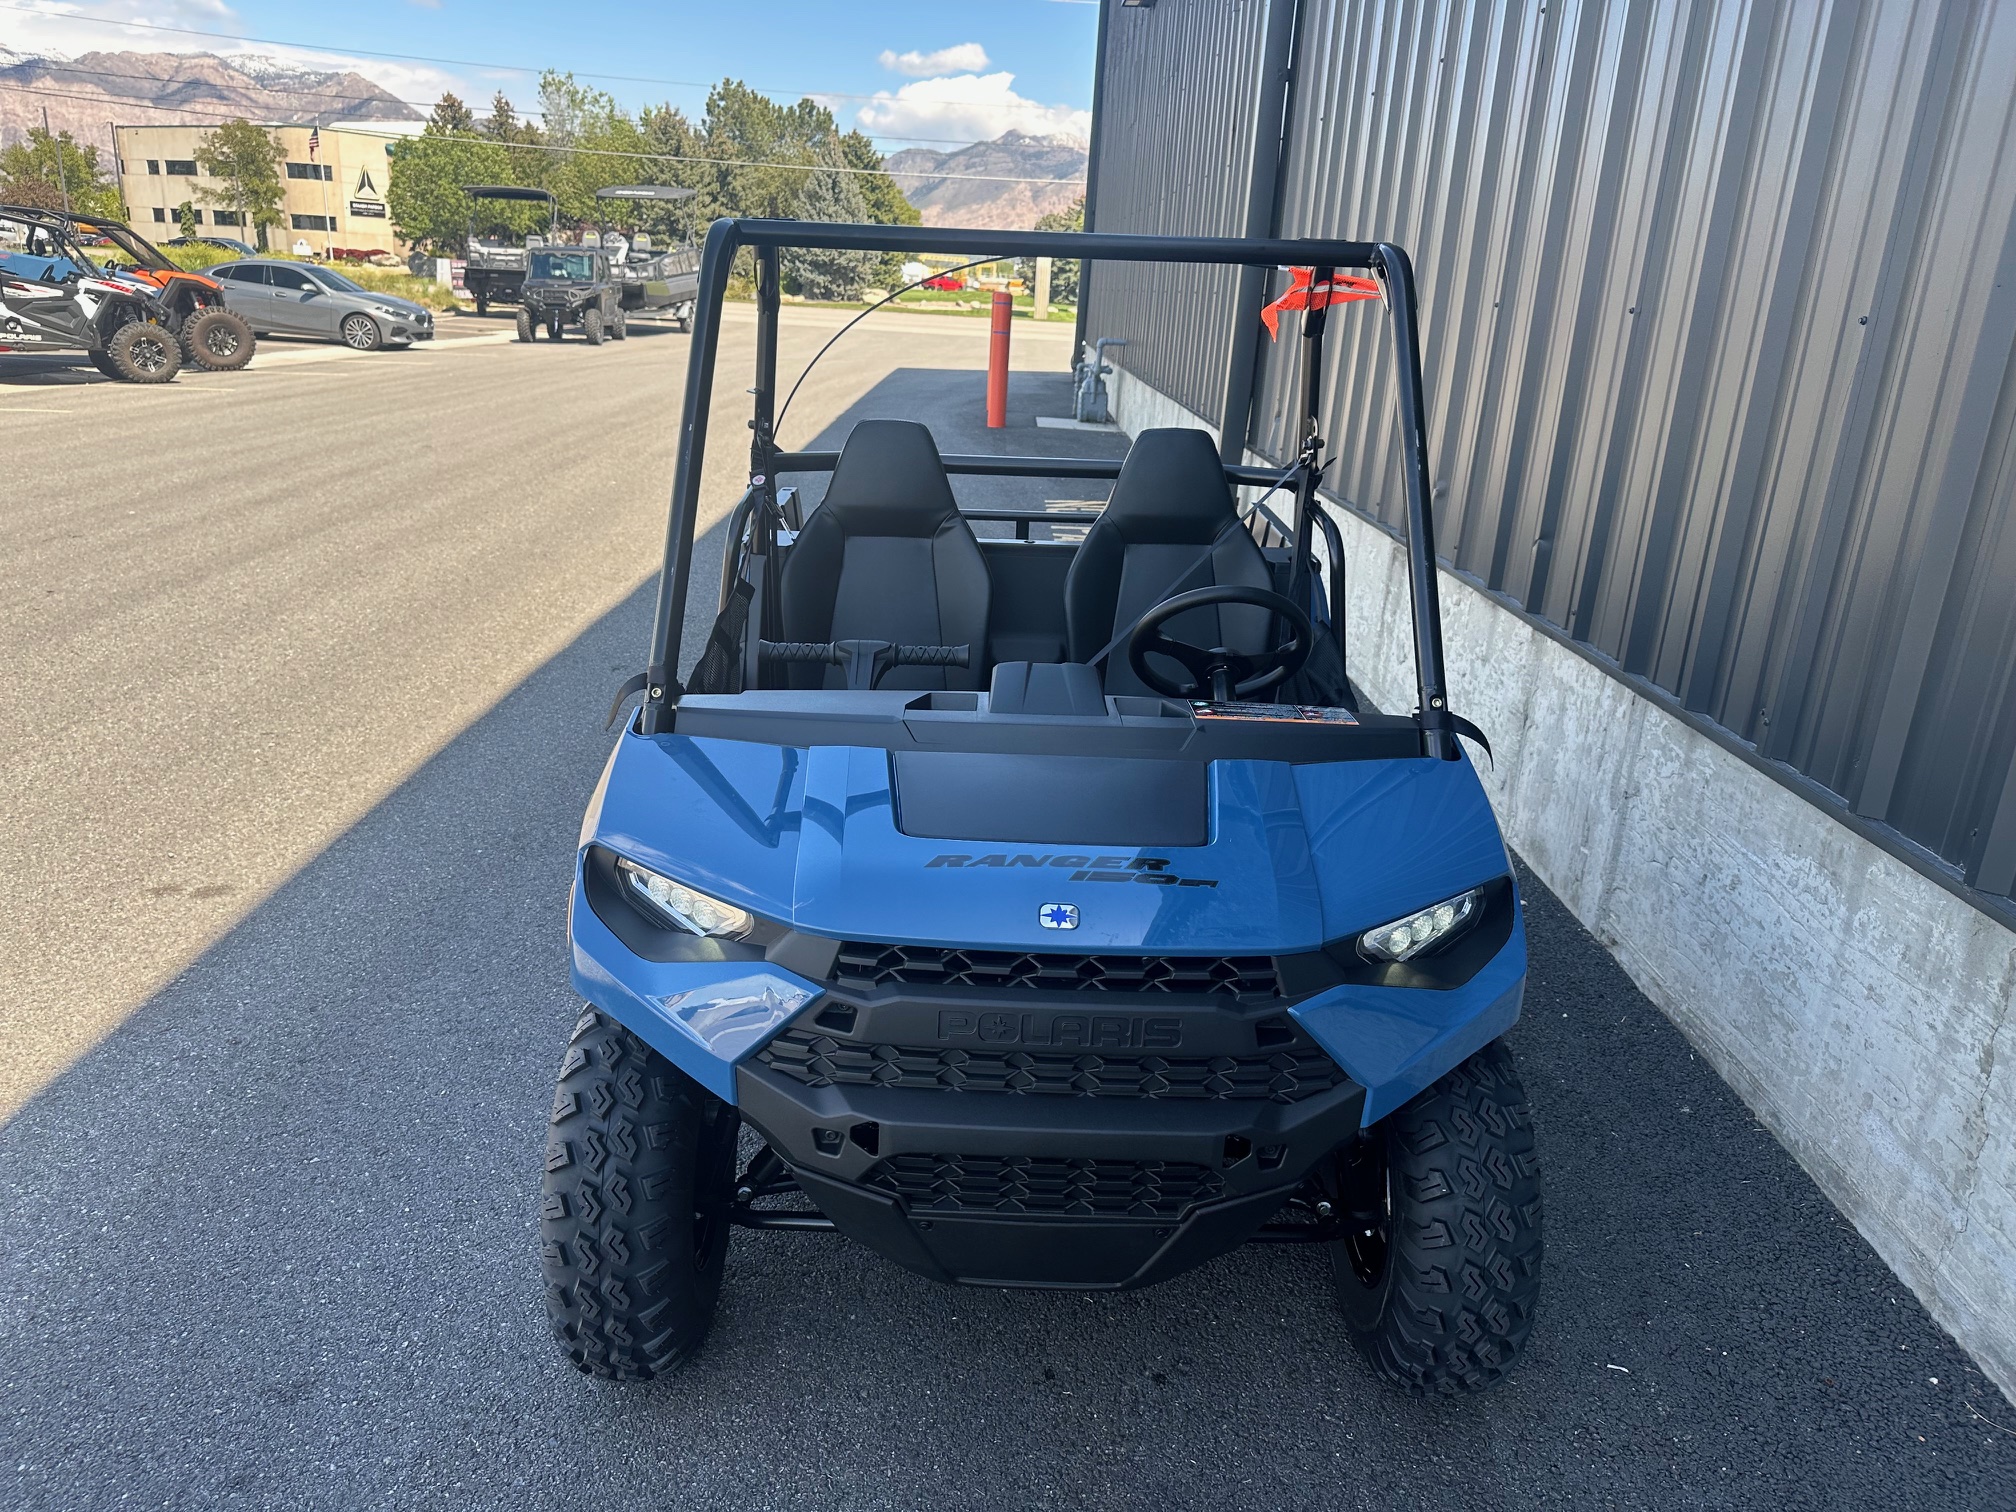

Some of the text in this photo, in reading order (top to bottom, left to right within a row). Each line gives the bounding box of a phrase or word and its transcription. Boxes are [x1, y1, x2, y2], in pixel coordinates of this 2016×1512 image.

[924, 854, 1172, 872] RANGER
[1068, 870, 1180, 886] 150
[937, 1010, 1184, 1048] POLARIS
